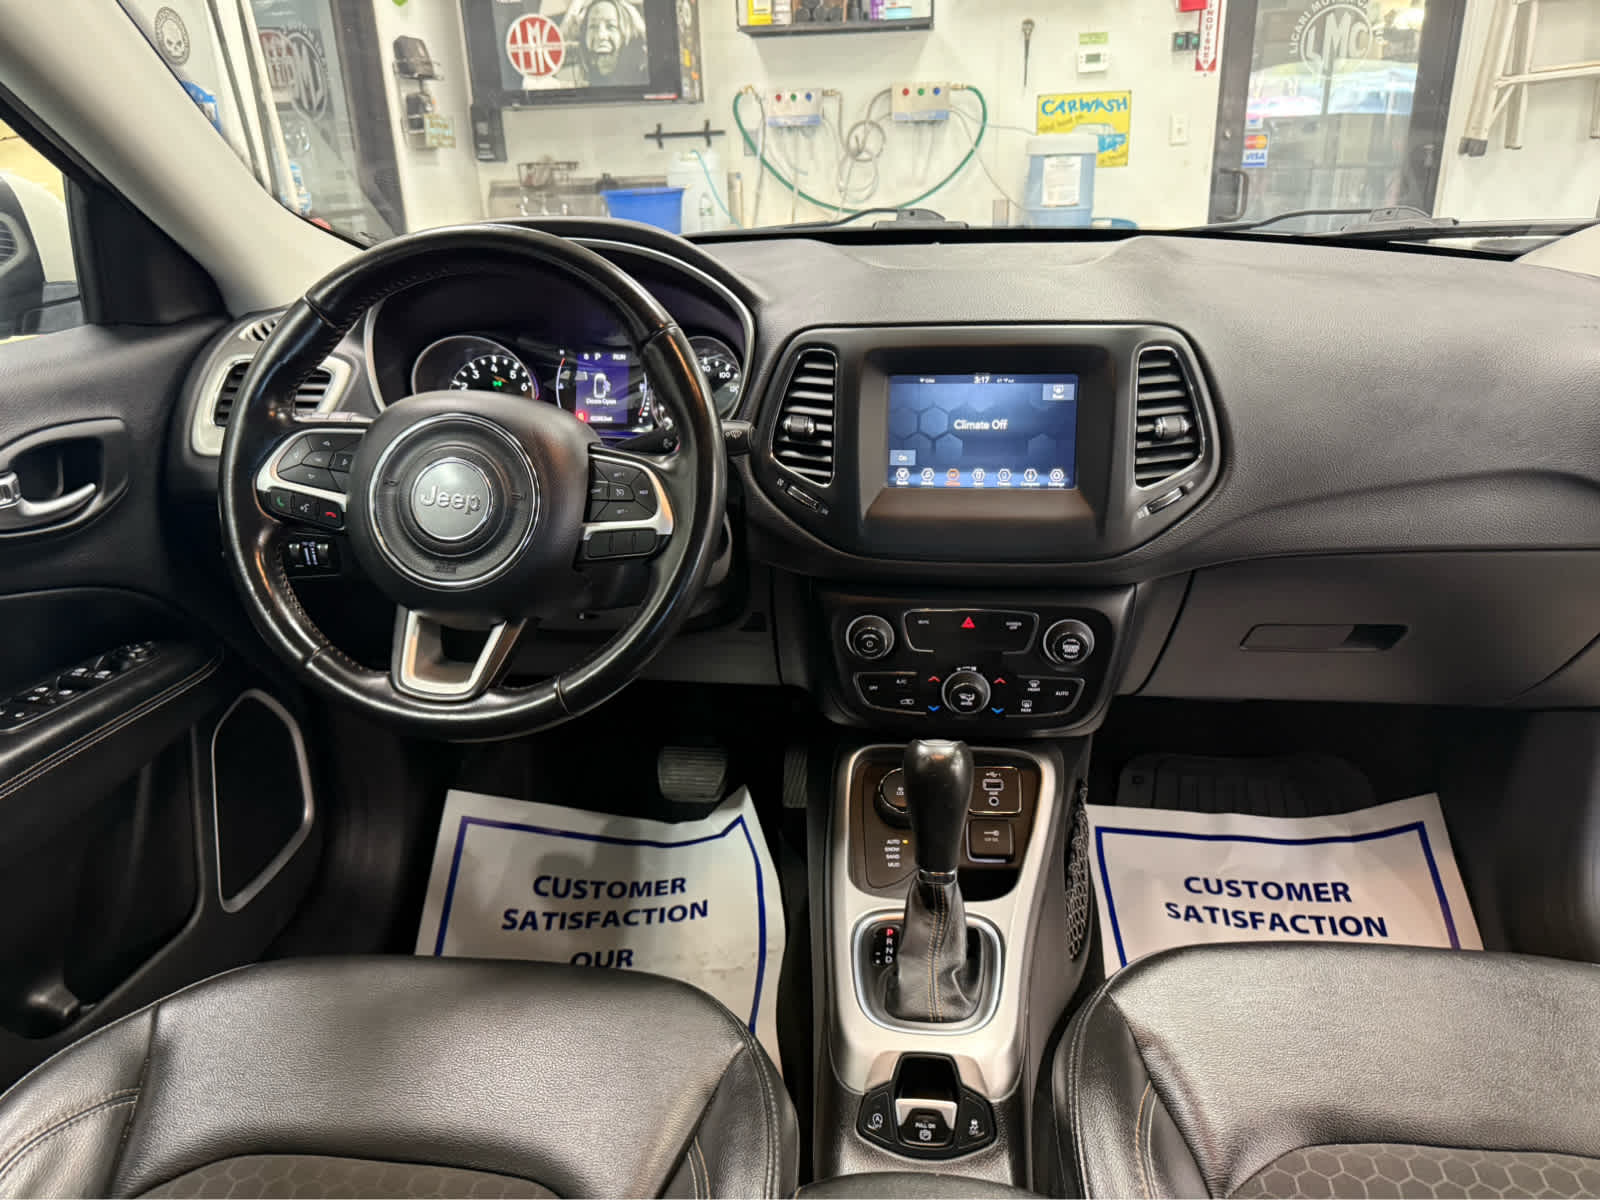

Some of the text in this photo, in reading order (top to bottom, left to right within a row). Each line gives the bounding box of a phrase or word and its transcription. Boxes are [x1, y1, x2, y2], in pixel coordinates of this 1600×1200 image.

[1305, 11, 1369, 77] LMC
[472, 370, 479, 379] 3
[491, 364, 498, 373] 4
[520, 383, 528, 391] 6
[974, 375, 990, 384] 3:17
[953, 418, 1008, 430] Climate Off
[420, 485, 481, 516] Jeep
[532, 875, 687, 900] CUSTOMER
[1183, 876, 1353, 903] CUSTOMER
[501, 899, 709, 931] SATISFACTION
[1164, 901, 1389, 938] SATISFACTION
[886, 928, 894, 937] P
[570, 948, 634, 968] OUR
[885, 955, 893, 964] D
